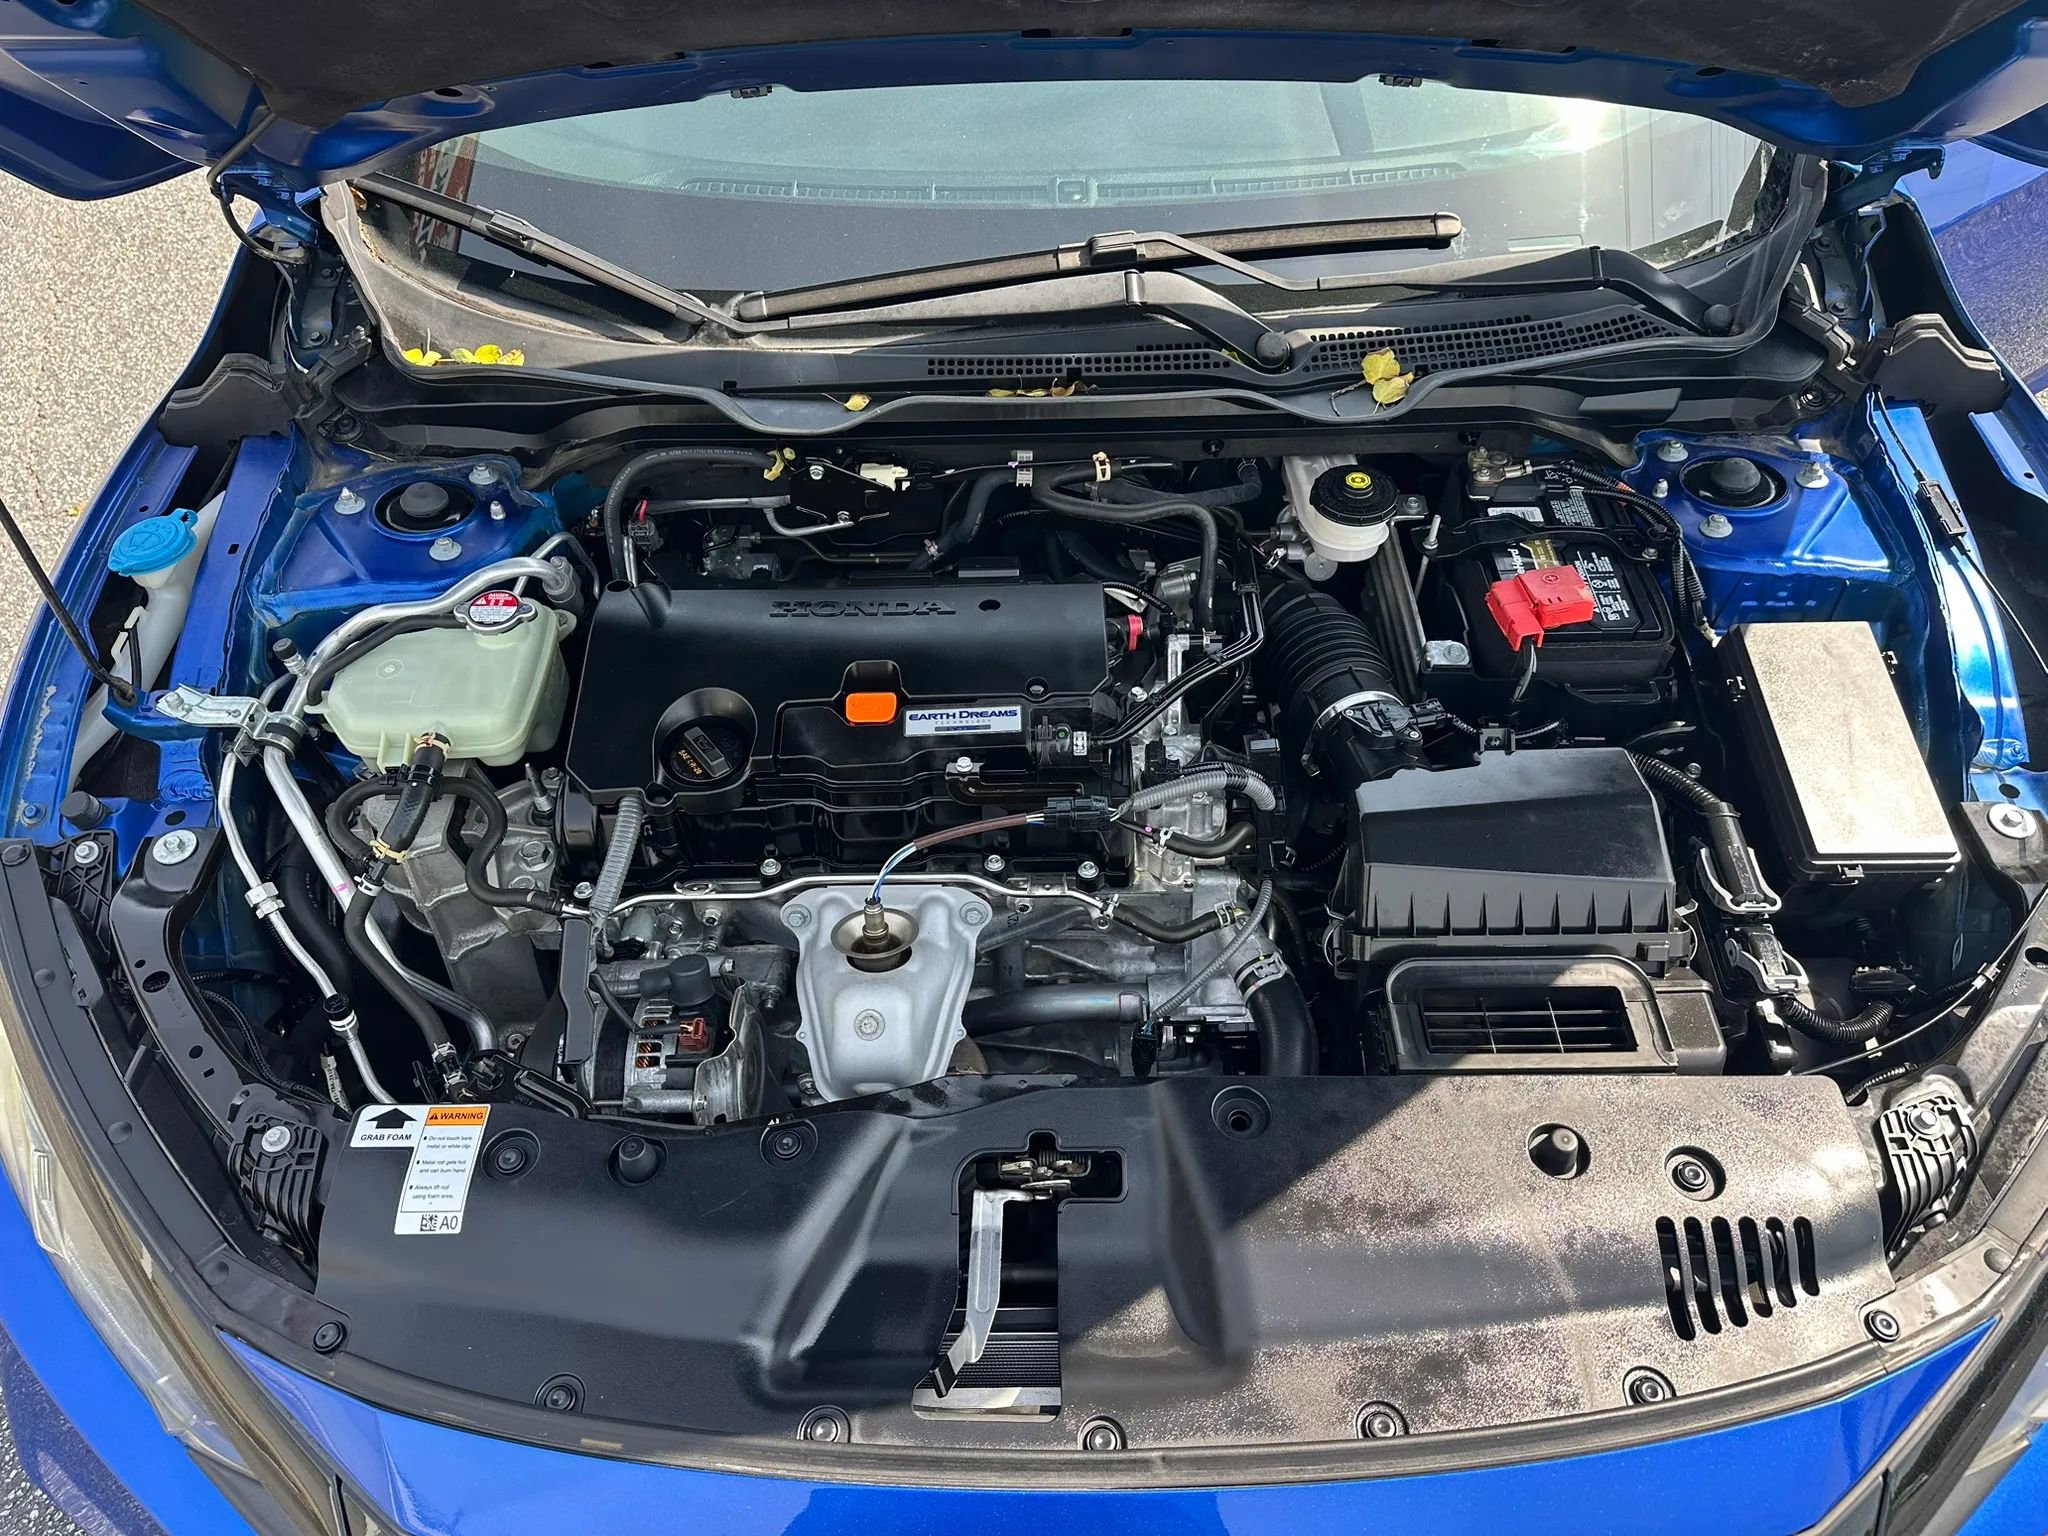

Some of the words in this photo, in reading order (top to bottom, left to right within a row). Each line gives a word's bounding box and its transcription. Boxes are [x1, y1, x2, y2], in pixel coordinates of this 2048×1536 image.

[769, 600, 957, 617] HONDA
[908, 710, 956, 721] EARTH
[958, 709, 1018, 719] DREAMS
[440, 1112, 484, 1121] WARNING
[360, 1133, 385, 1141] GRAB
[386, 1133, 412, 1141] FOAM
[439, 1215, 459, 1230] A0
